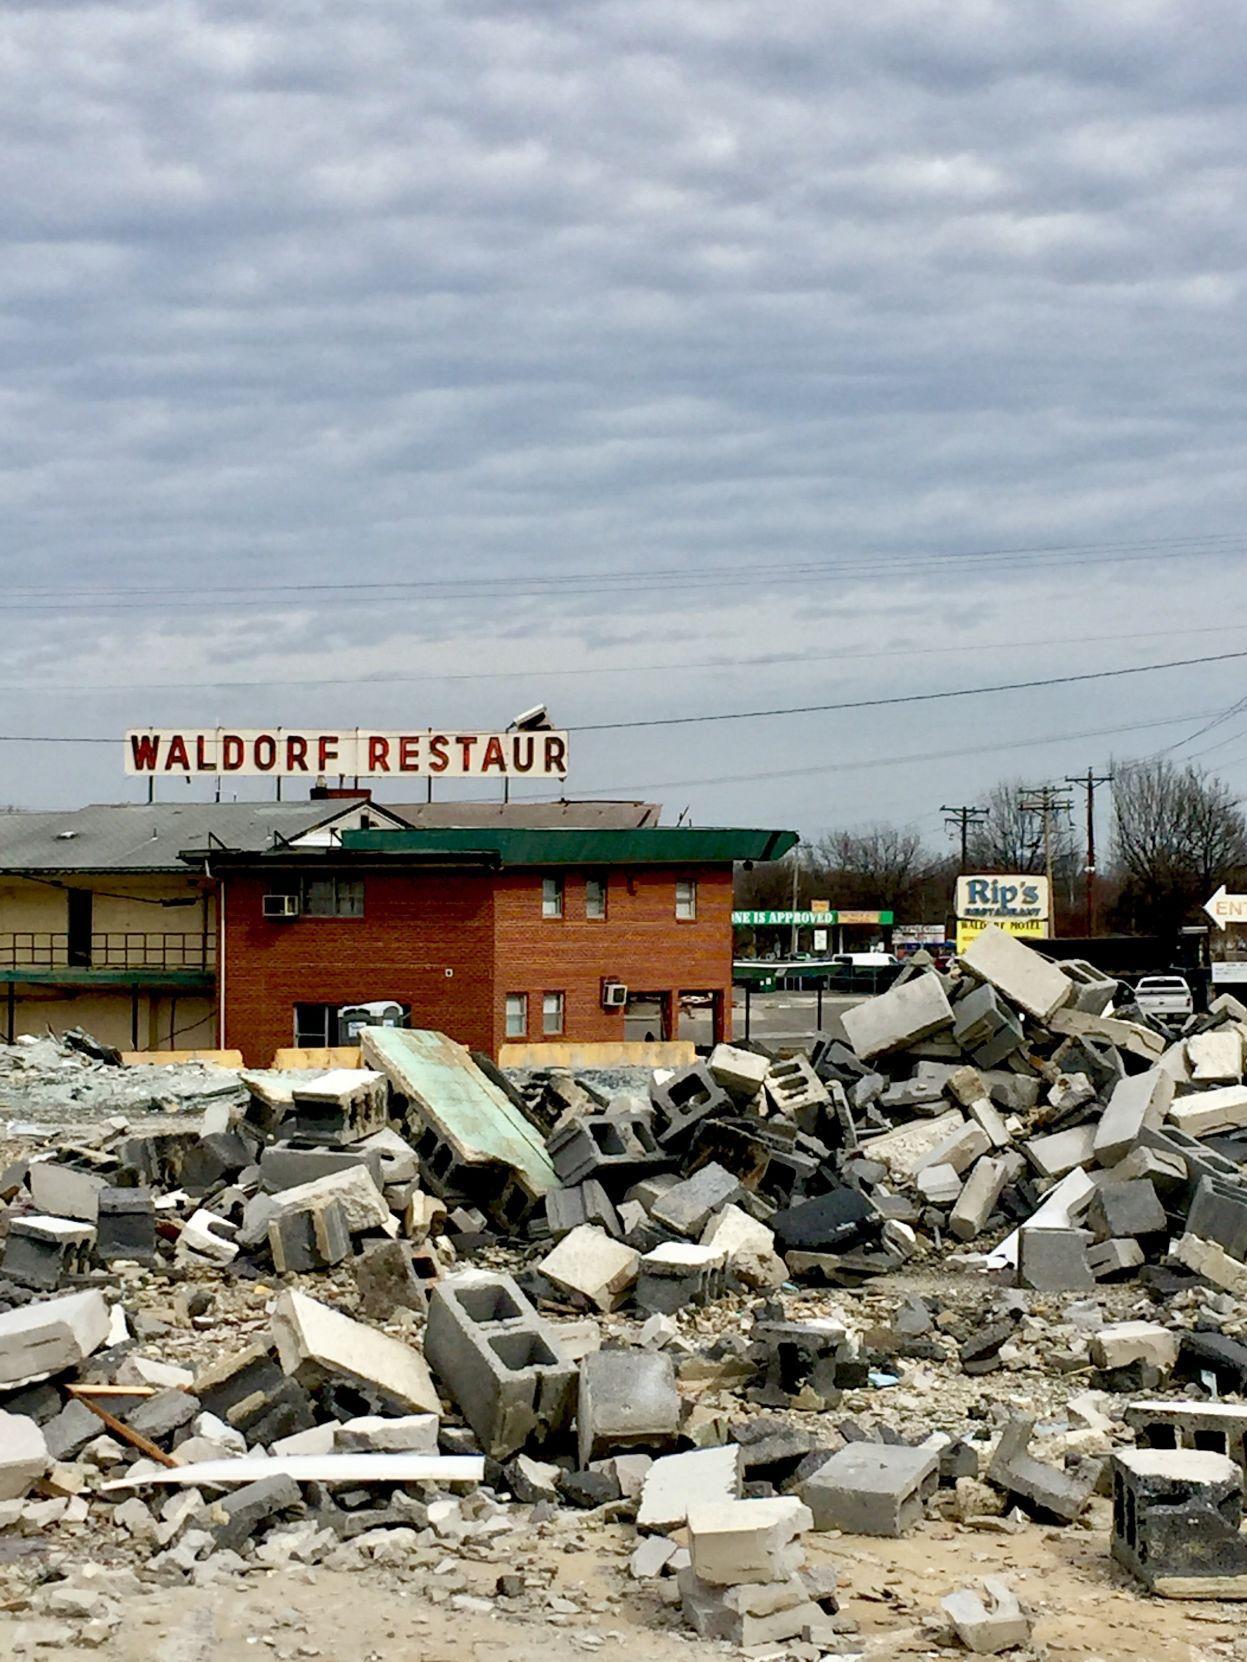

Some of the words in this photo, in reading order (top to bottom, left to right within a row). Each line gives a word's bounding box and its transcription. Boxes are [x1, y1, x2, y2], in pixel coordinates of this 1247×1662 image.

[131, 735, 338, 771] WALDORF
[369, 735, 567, 772] RESTAUR
[966, 879, 1039, 908] Rip's
[753, 911, 766, 924] IS
[769, 911, 833, 924] APPROVED
